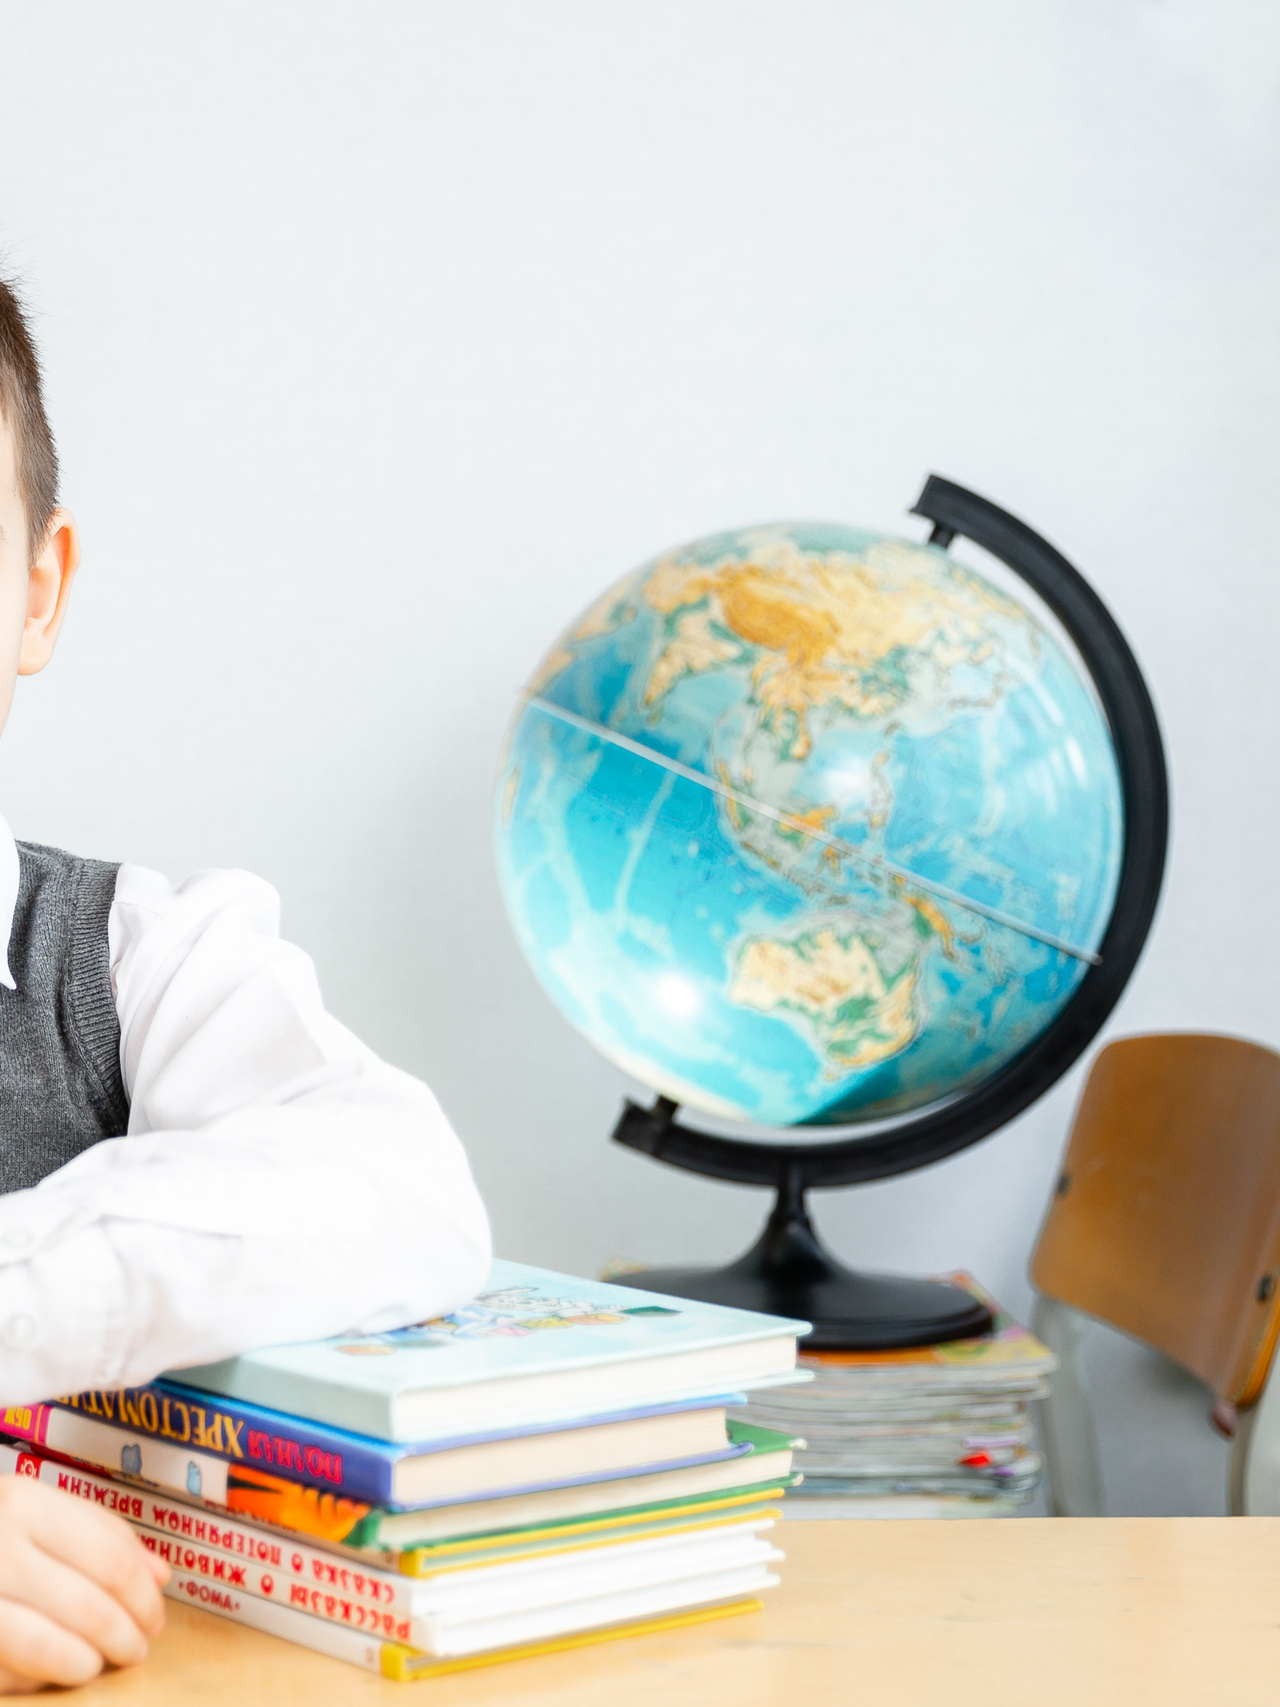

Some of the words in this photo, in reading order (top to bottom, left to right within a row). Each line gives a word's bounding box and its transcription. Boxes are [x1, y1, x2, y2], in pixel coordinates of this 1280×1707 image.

[55, 1389, 244, 1458] ХРЕСТОМАТ
[248, 1429, 342, 1483] ПОЛНАЯ
[58, 1473, 143, 1519] ВРЕМЕНИ
[140, 1534, 246, 1588] ЖИВОТНЫ
[152, 1505, 282, 1567] ПОТЕРЯННОМ
